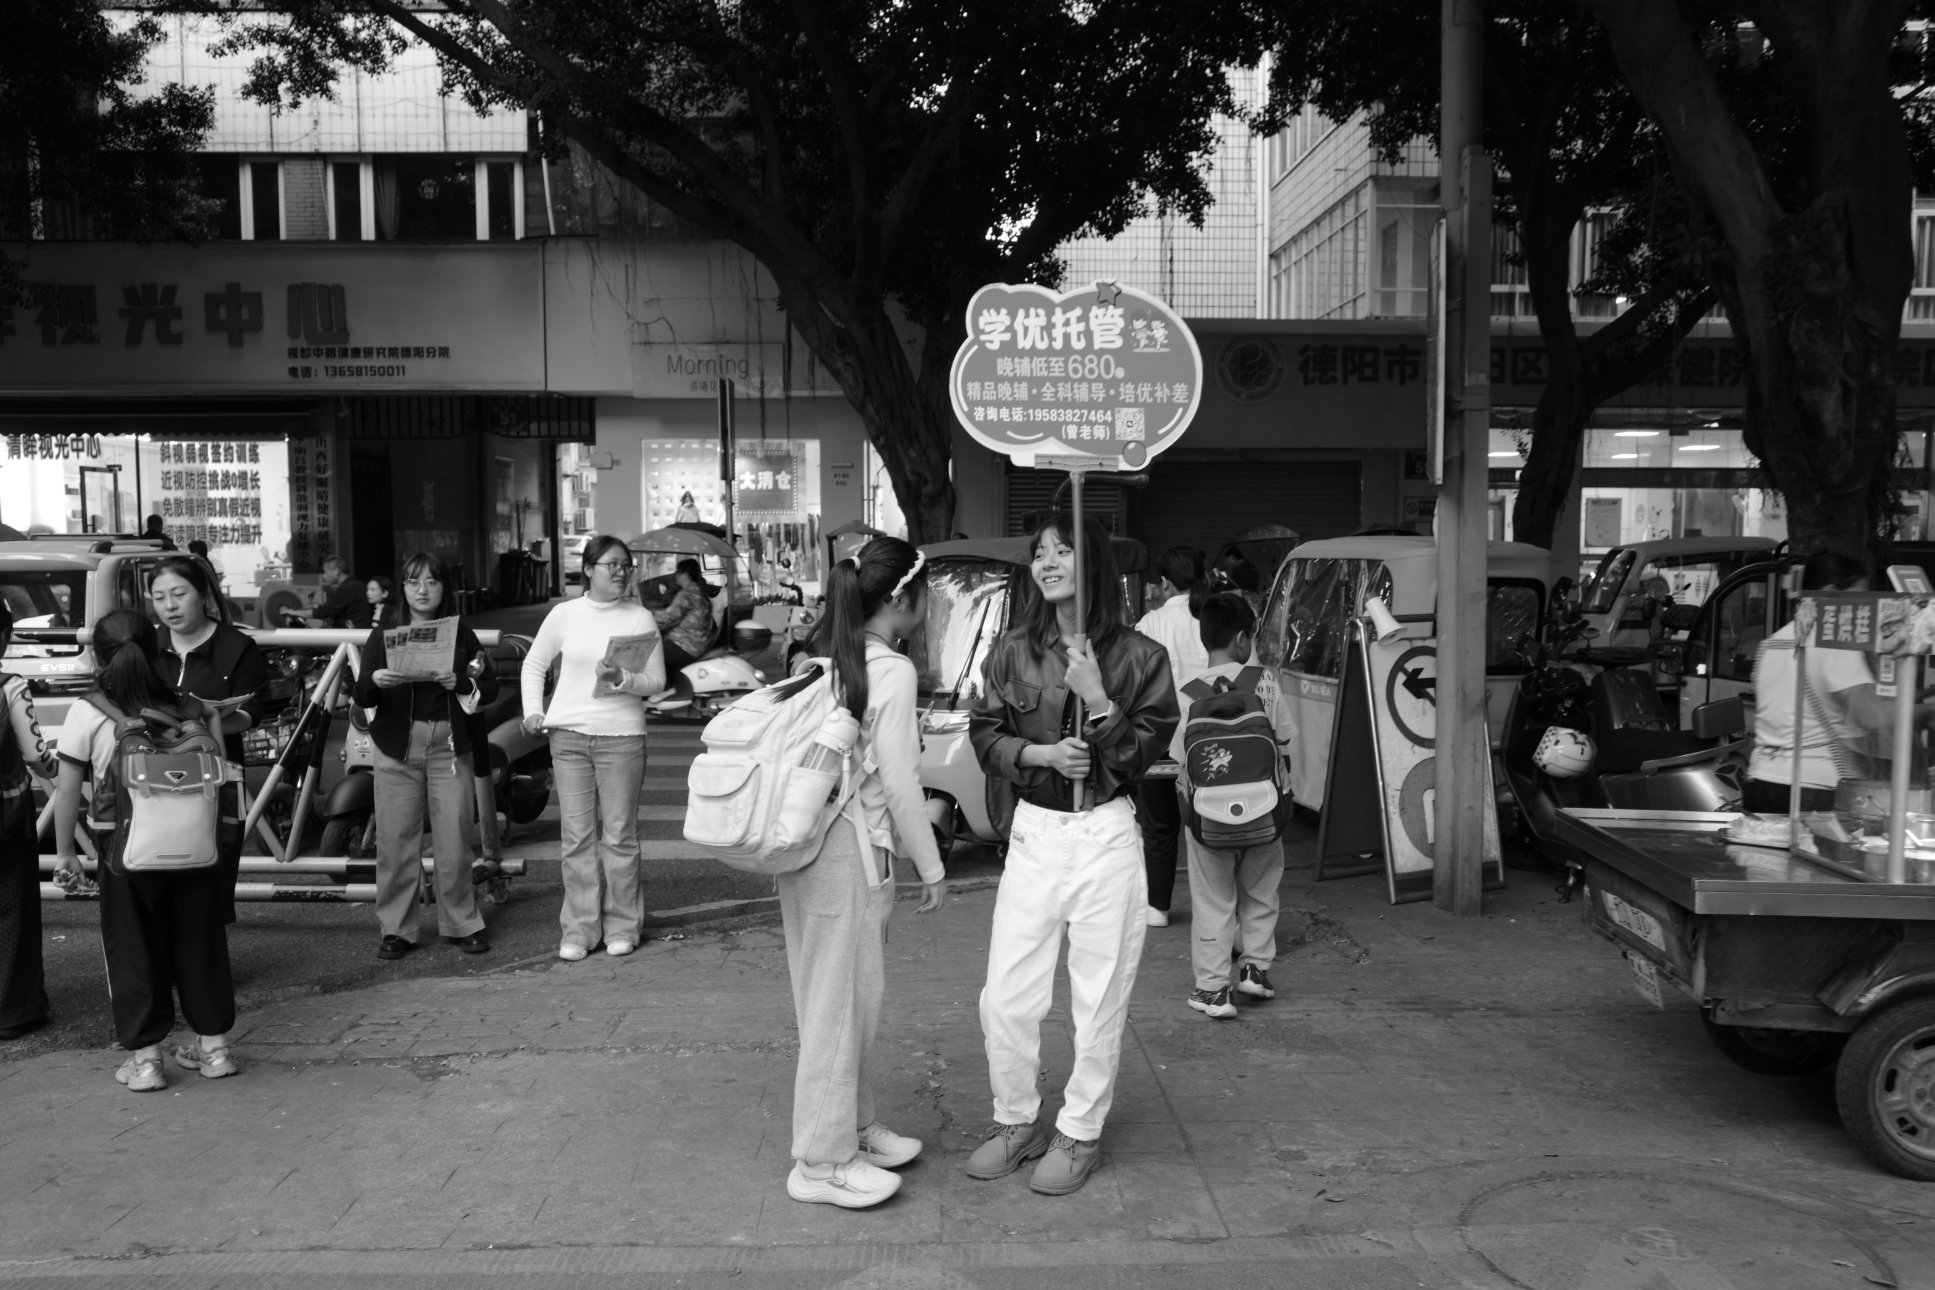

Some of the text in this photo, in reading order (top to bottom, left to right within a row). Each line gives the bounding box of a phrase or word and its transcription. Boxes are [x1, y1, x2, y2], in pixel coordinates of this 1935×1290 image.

[978, 306, 1125, 350] 学优托管
[667, 353, 749, 379] Morning
[974, 406, 1113, 423] 咨询电话:19583827464
[1061, 424, 1110, 440] (曾老师)
[160, 441, 260, 464] 斜视弱视签约训练
[161, 469, 260, 491] 近视防控挑战0增长
[739, 470, 792, 490] 大清仓
[163, 497, 262, 518] 免散瞳辨别真假近视
